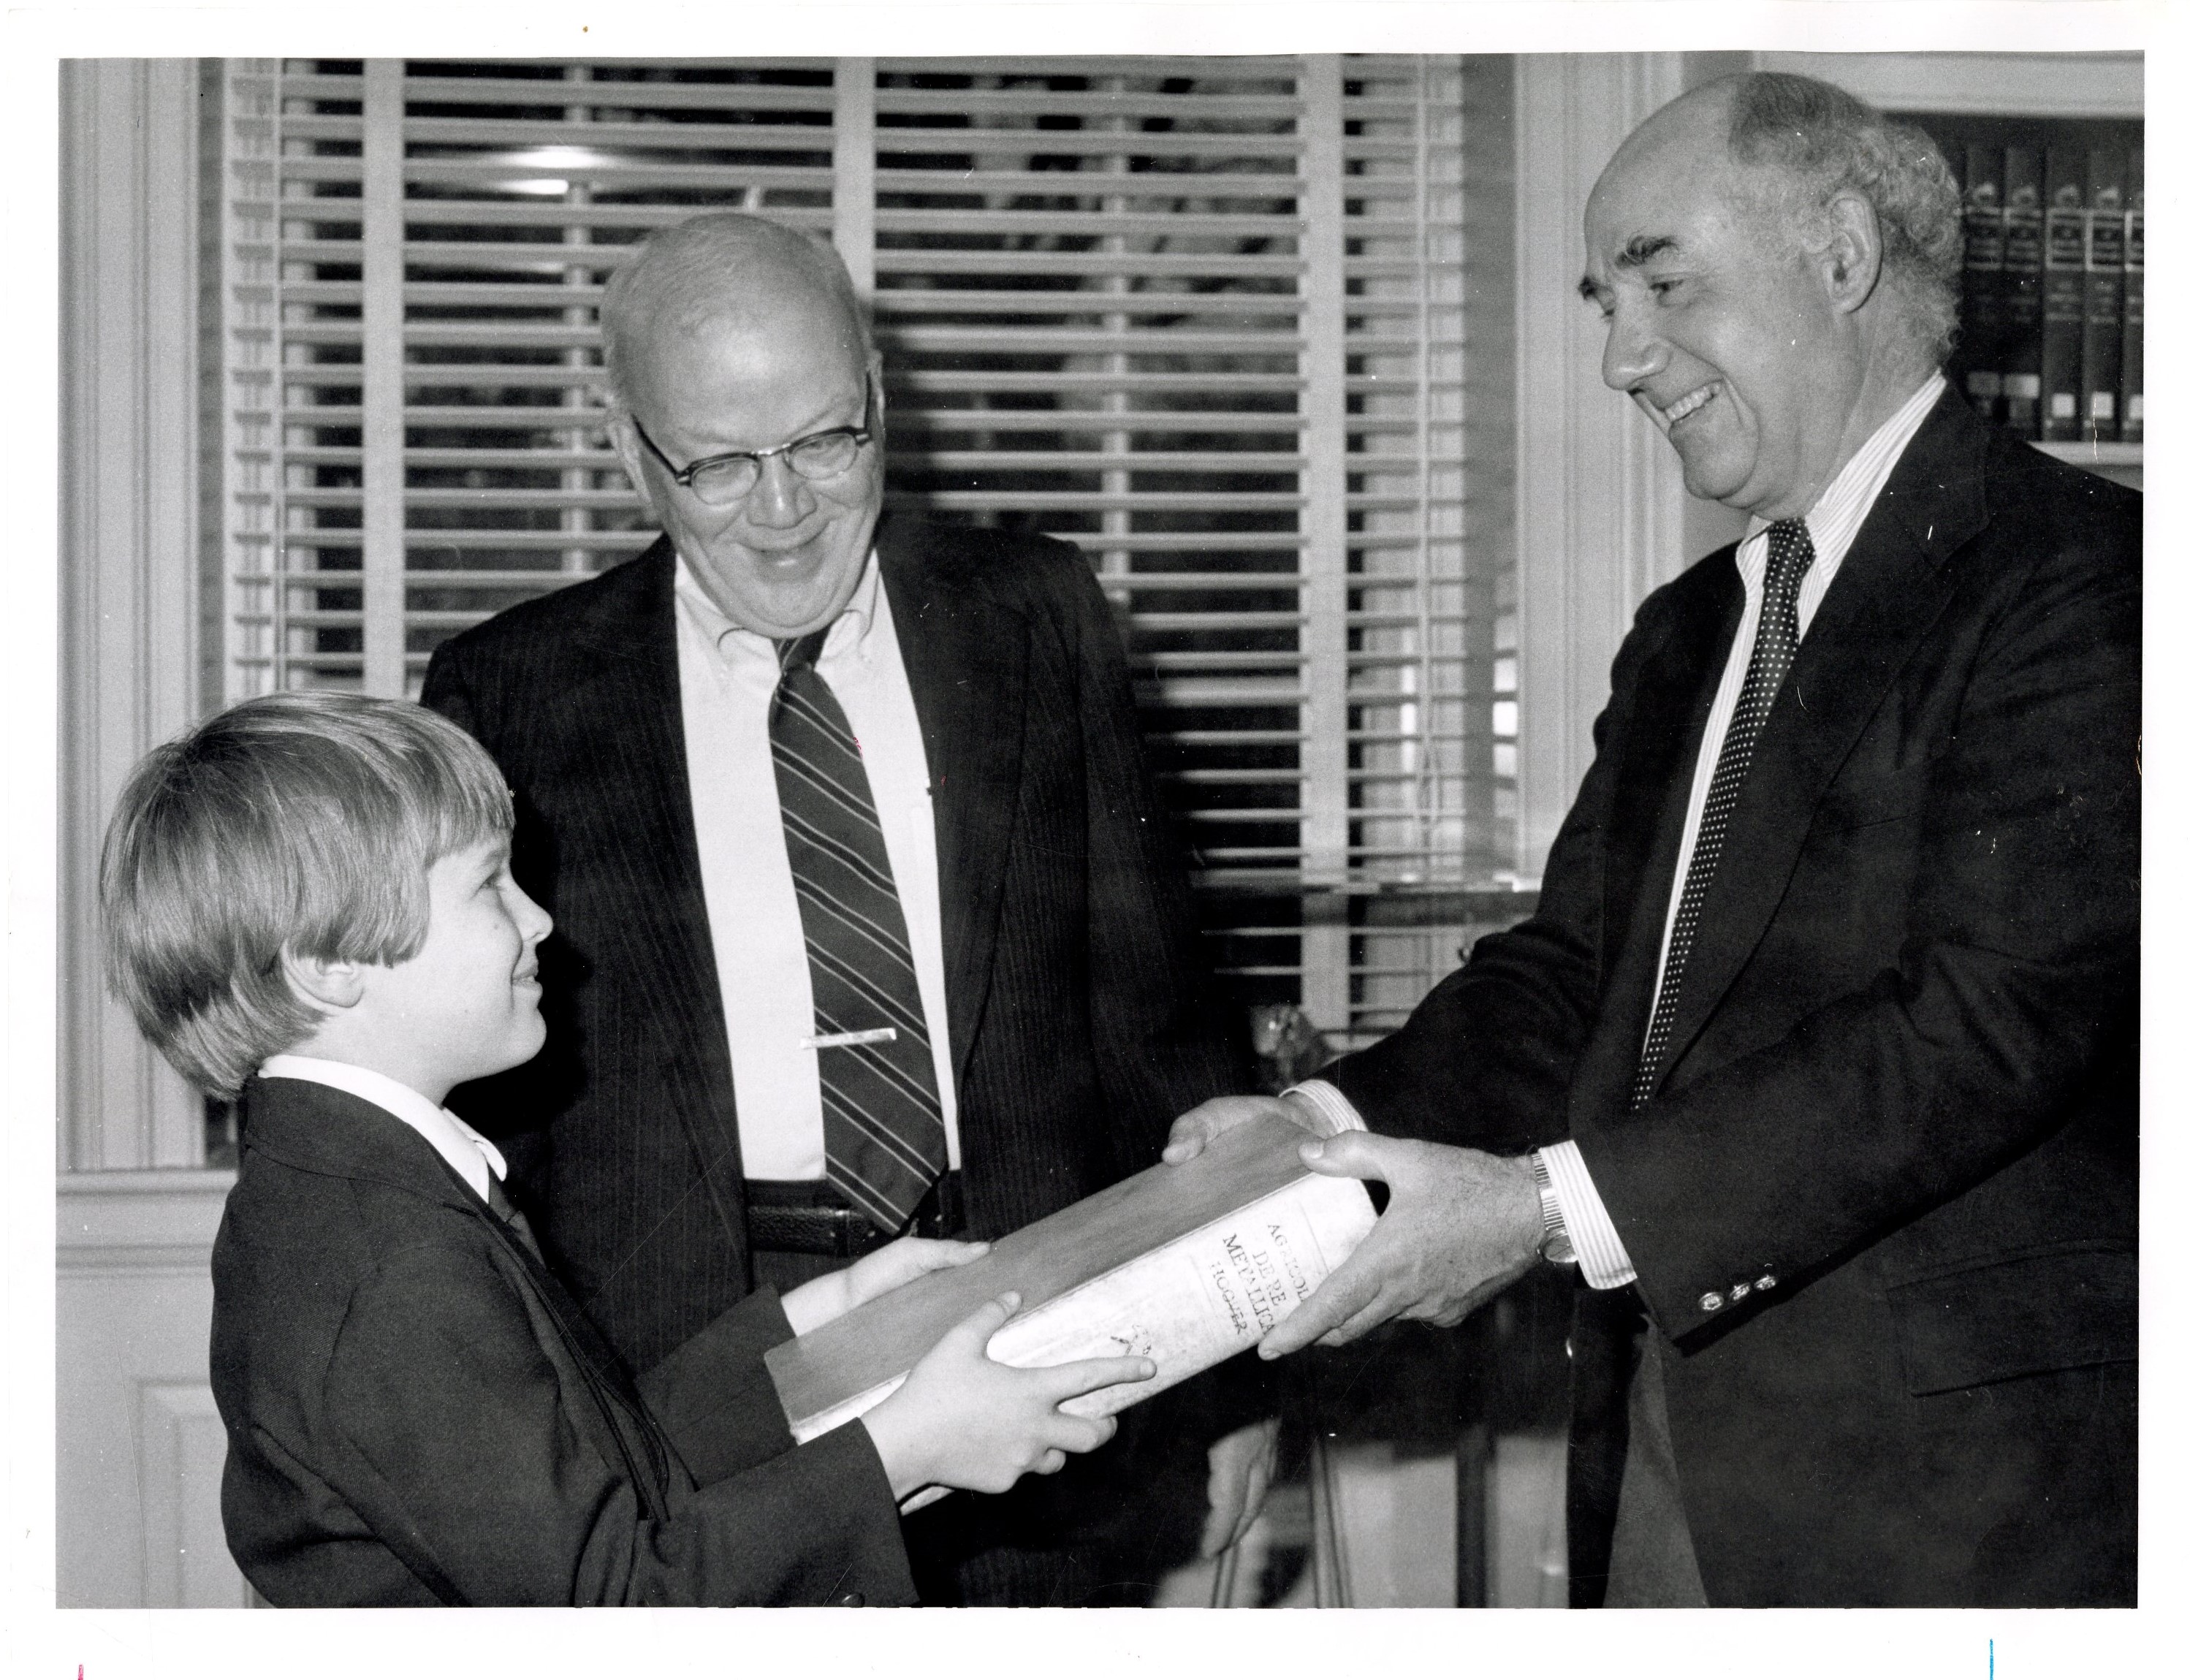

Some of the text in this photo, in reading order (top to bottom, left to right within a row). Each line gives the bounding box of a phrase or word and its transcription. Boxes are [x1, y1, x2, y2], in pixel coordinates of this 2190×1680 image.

[1223, 1234, 1275, 1335] METALLICA
[1252, 1251, 1286, 1306] DE RE
[1268, 1224, 1309, 1301] AGRICOL
